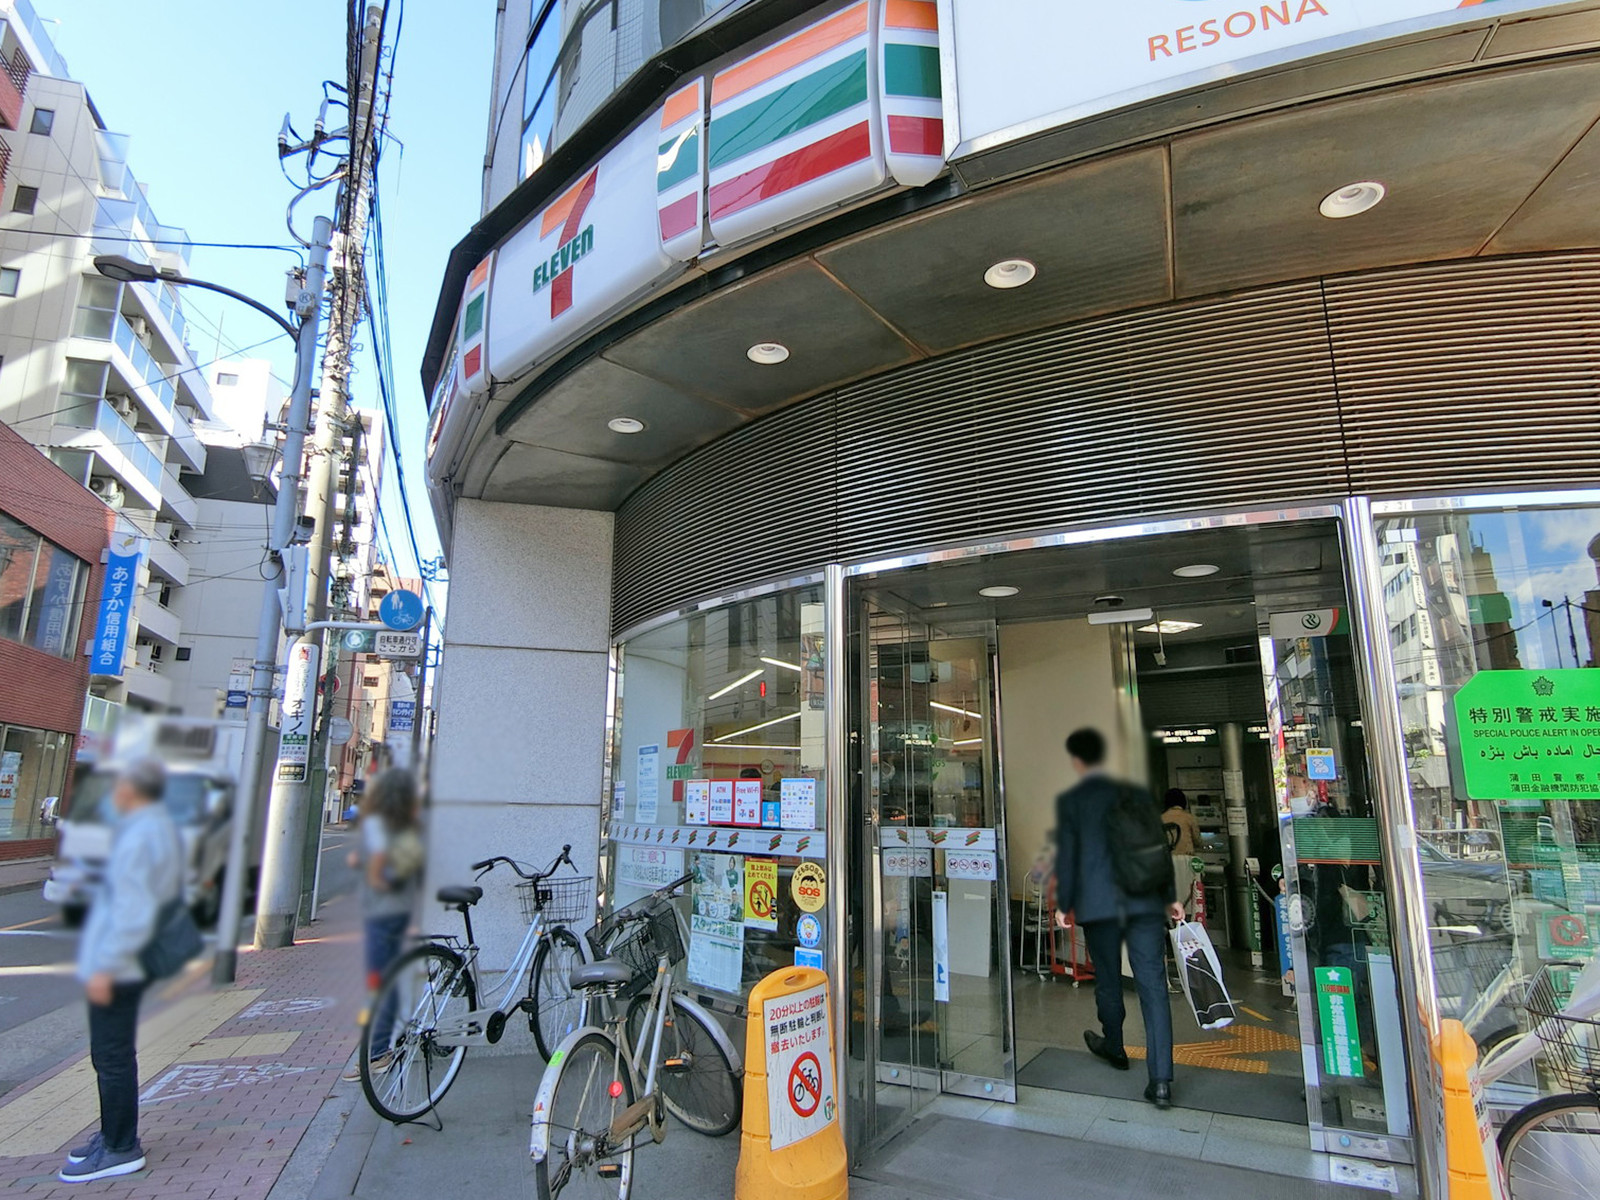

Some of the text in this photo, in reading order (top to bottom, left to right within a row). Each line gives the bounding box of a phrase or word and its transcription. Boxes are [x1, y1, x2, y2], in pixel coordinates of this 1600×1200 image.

[1147, 0, 1328, 62] RESONA
[540, 165, 599, 321] 7
[99, 566, 129, 666] あすか信用組合
[379, 644, 416, 653] ここから
[380, 635, 418, 645] 自転車通行可
[289, 698, 306, 732] オギノ
[1469, 706, 1600, 724] 特別警戒実施
[1473, 728, 1508, 738] SPECIAL
[1510, 728, 1540, 738] POLICE
[1542, 728, 1568, 738] ALERT
[1570, 728, 1579, 737] IN
[667, 728, 695, 802] 7
[1509, 773, 1600, 782] 蒲田警察
[736, 786, 759, 794] Free Wi-Fi
[798, 886, 821, 897] SOS
[769, 993, 825, 1021] 20分以上の駐輪は
[770, 1008, 826, 1037] 無断駐輪と判断し
